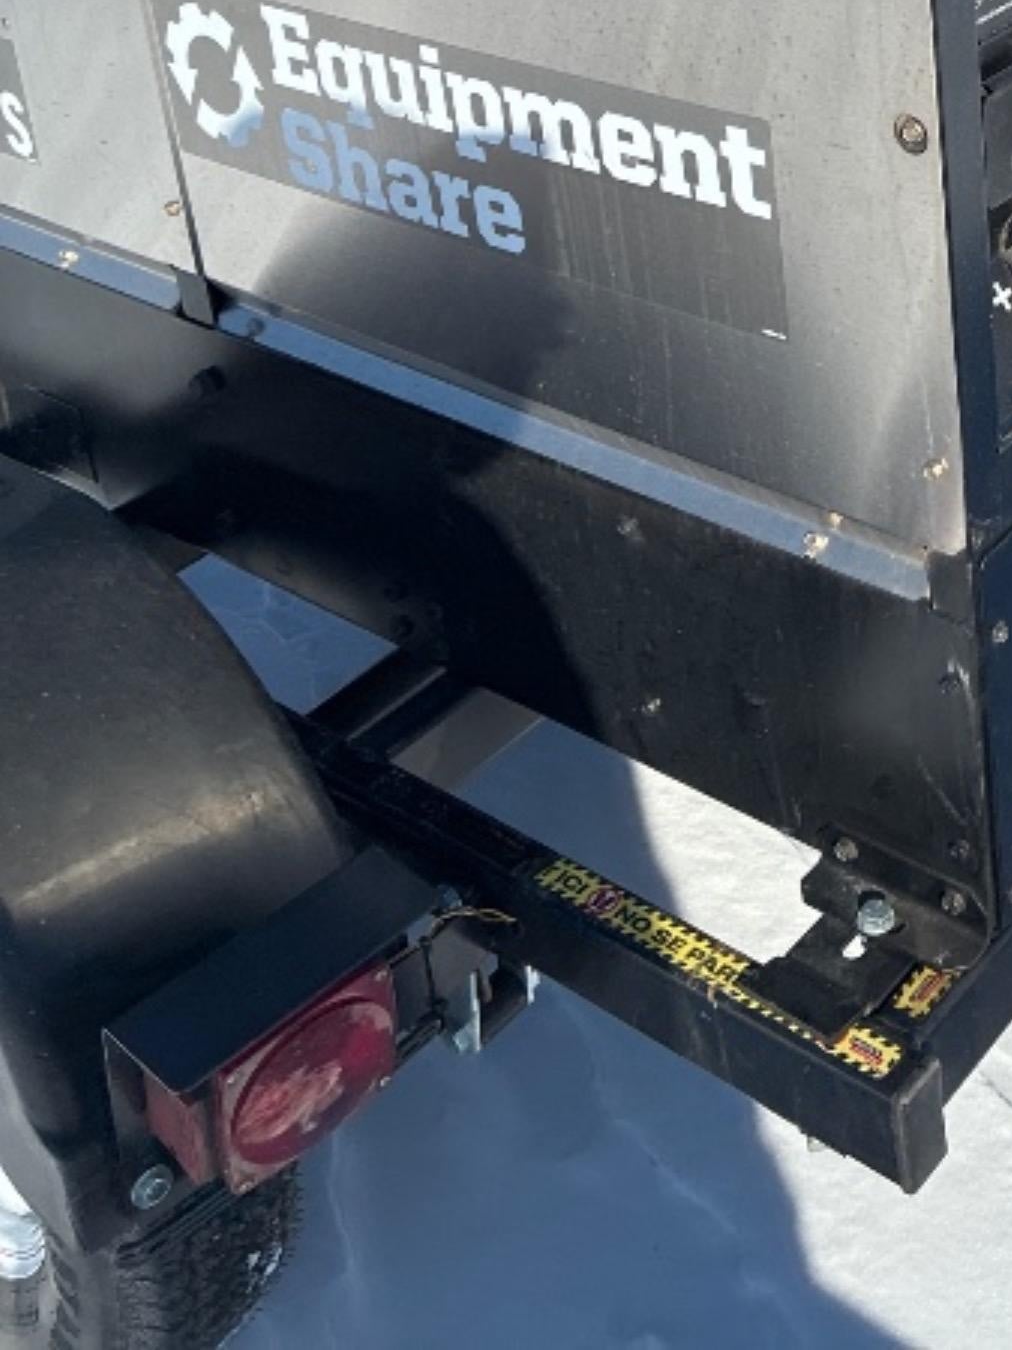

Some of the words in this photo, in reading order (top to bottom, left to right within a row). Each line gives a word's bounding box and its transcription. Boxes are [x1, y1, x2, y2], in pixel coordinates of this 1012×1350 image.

[260, 3, 773, 220] Equipment
[280, 104, 526, 254] Share
[553, 869, 589, 895] ICI
[614, 905, 650, 929] NO
[652, 929, 687, 951] SE
